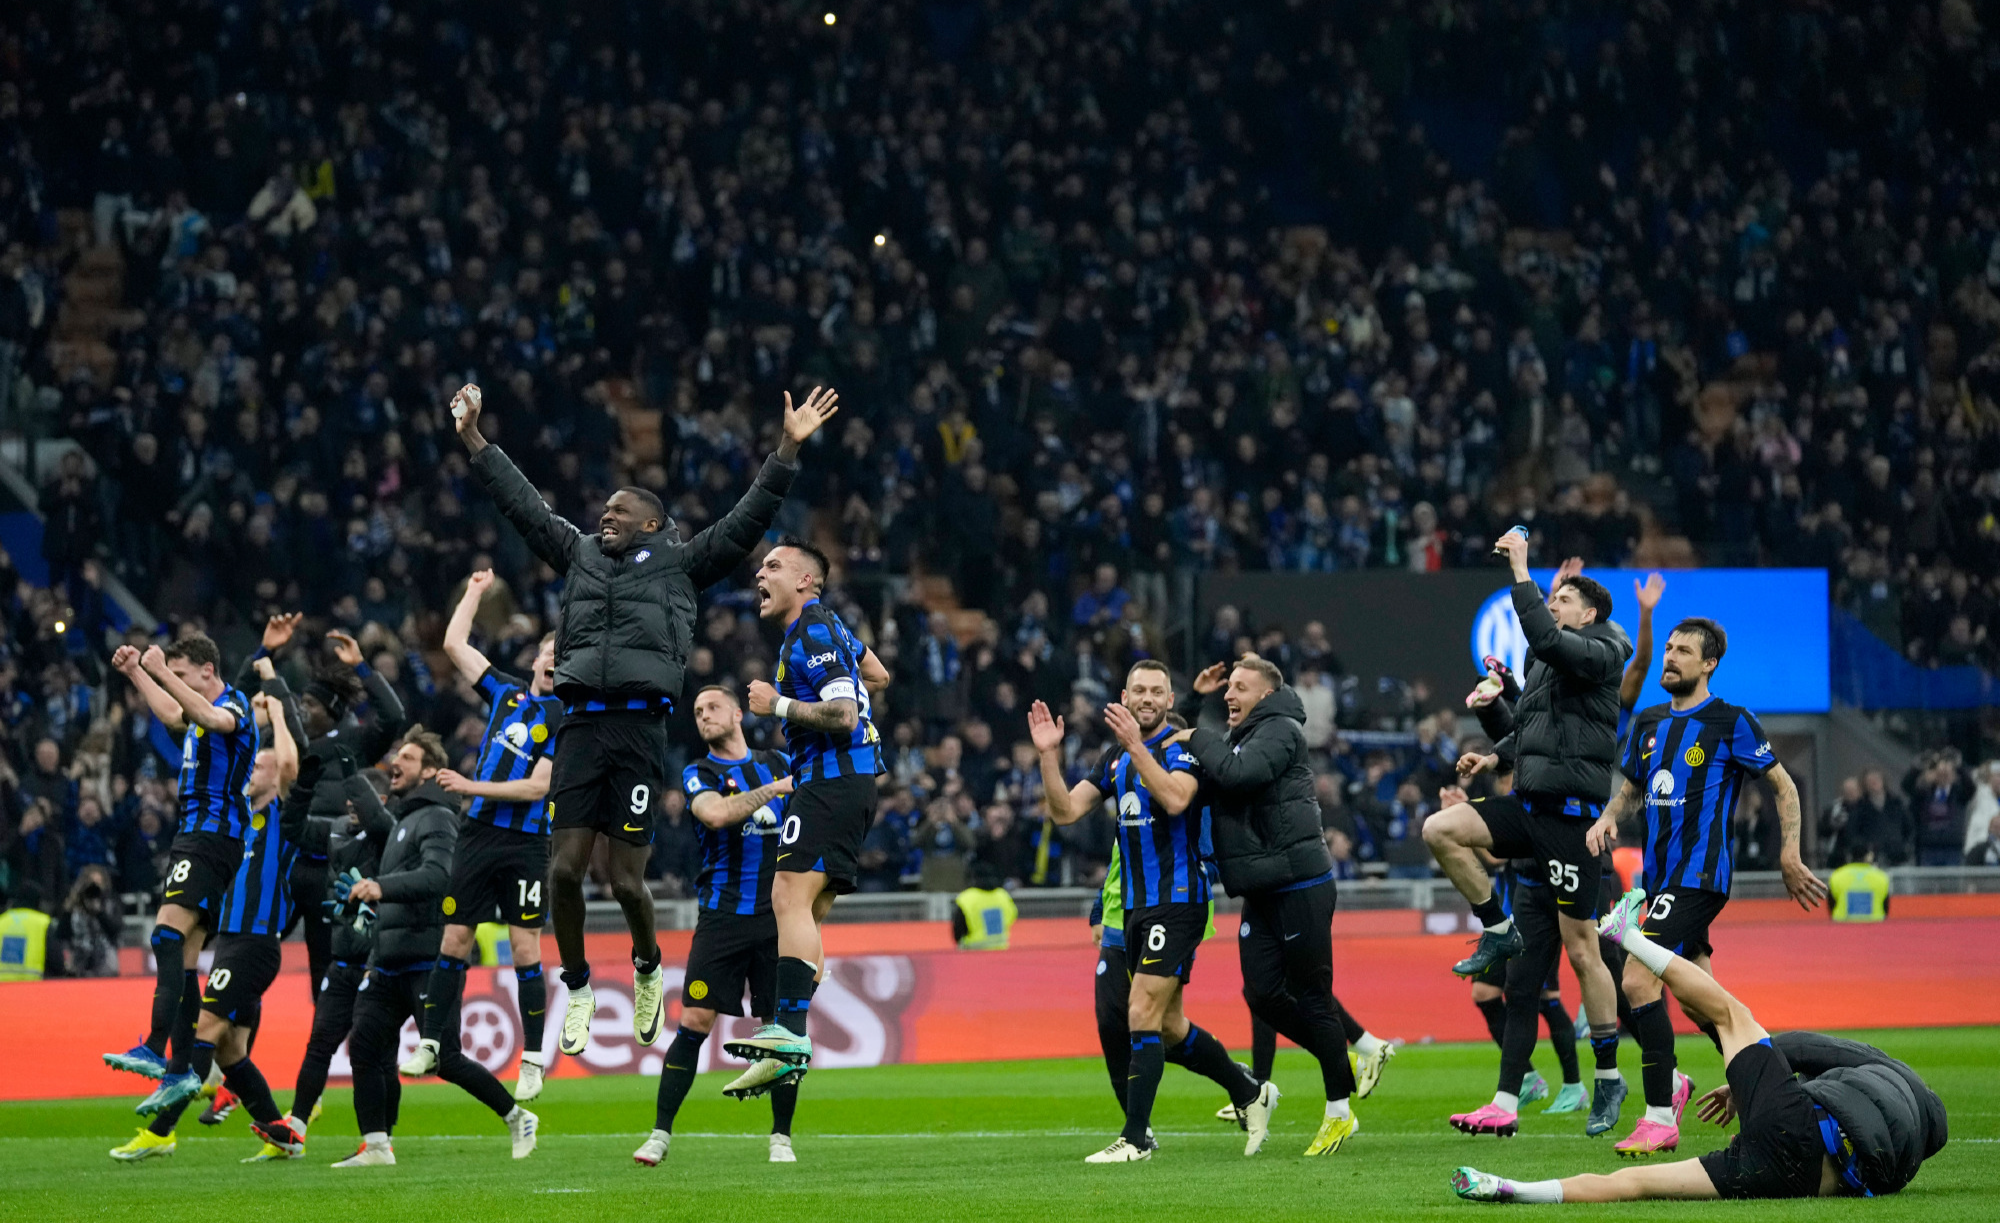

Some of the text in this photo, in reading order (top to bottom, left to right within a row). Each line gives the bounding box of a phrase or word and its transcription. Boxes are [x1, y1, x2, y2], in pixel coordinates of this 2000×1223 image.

[807, 650, 838, 669] ebay
[1178, 752, 1200, 766] eba
[1756, 740, 1772, 757] eba
[629, 784, 650, 814] 9
[778, 814, 801, 847] 0
[517, 879, 542, 908] 14
[1148, 923, 1167, 951] 6
